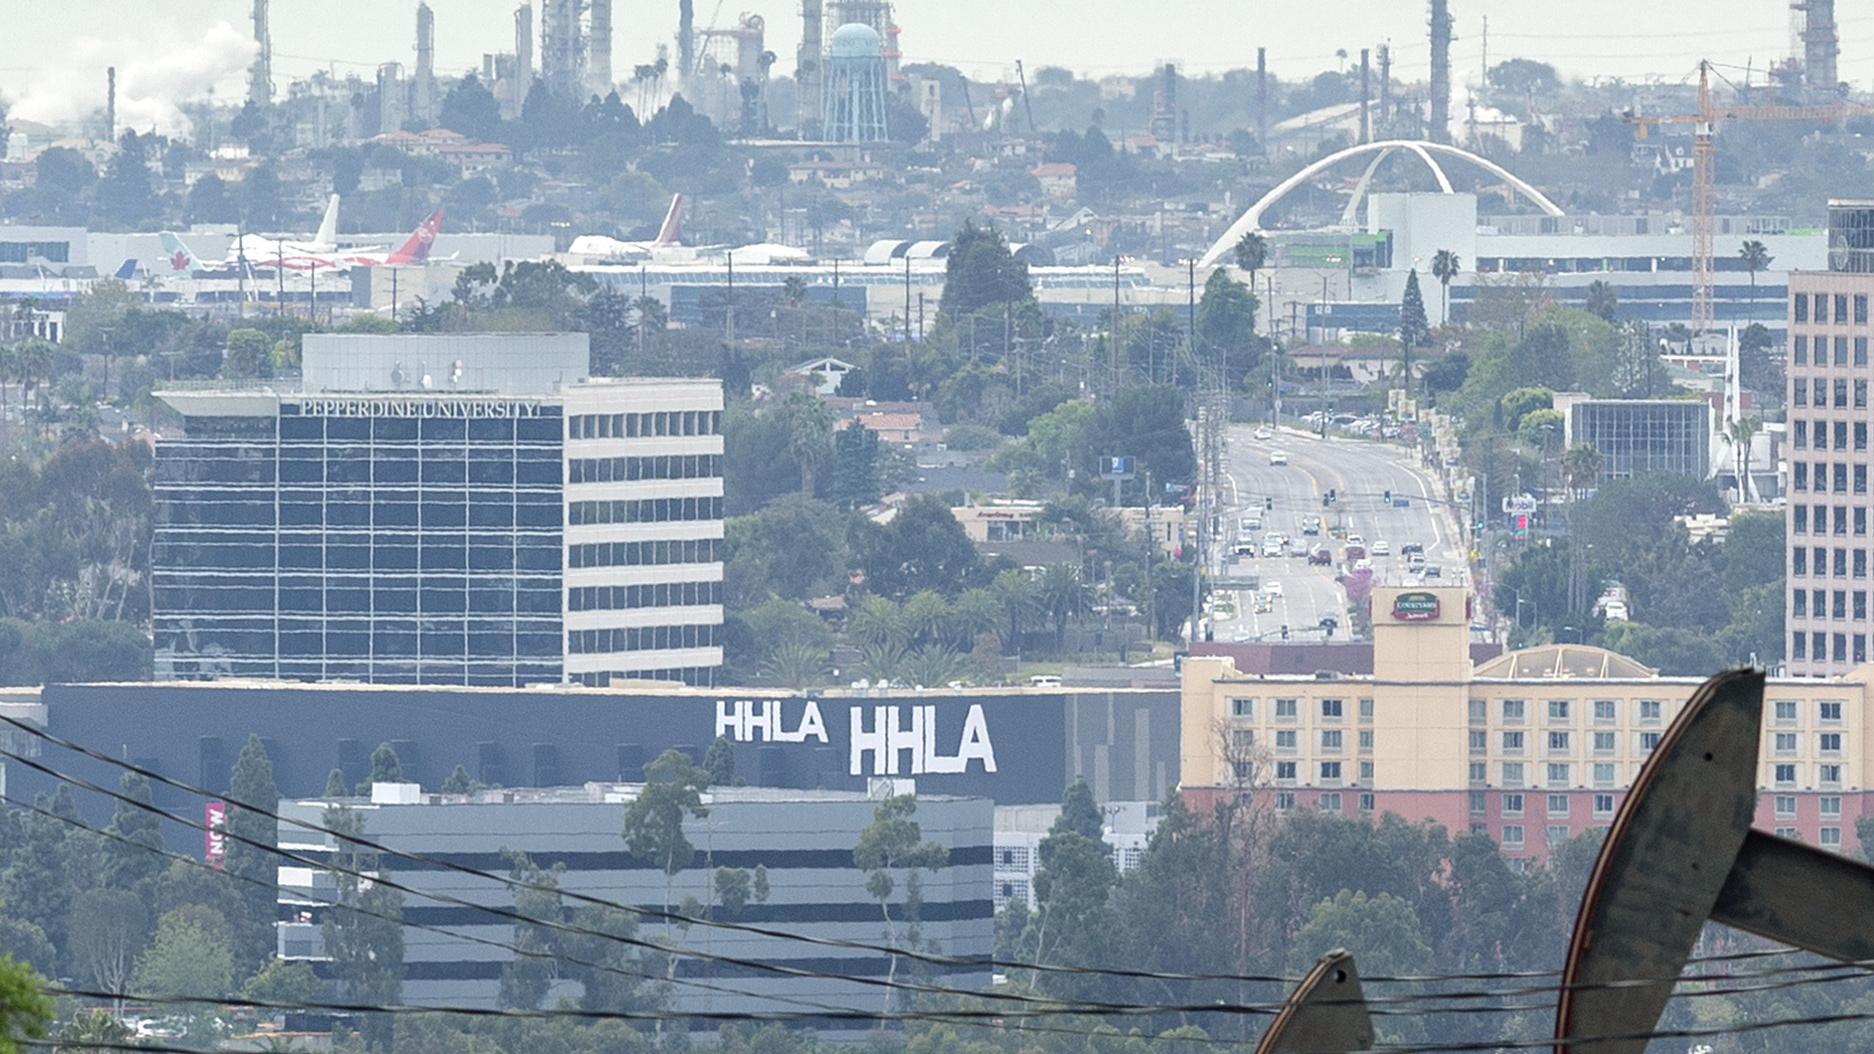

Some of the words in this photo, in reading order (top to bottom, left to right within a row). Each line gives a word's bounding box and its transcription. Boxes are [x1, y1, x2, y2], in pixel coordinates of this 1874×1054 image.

[300, 400, 418, 417] PEPPERDINE
[420, 400, 540, 418] UNIVERSITY
[715, 701, 829, 743] HHLA
[850, 704, 997, 776] HHLA
